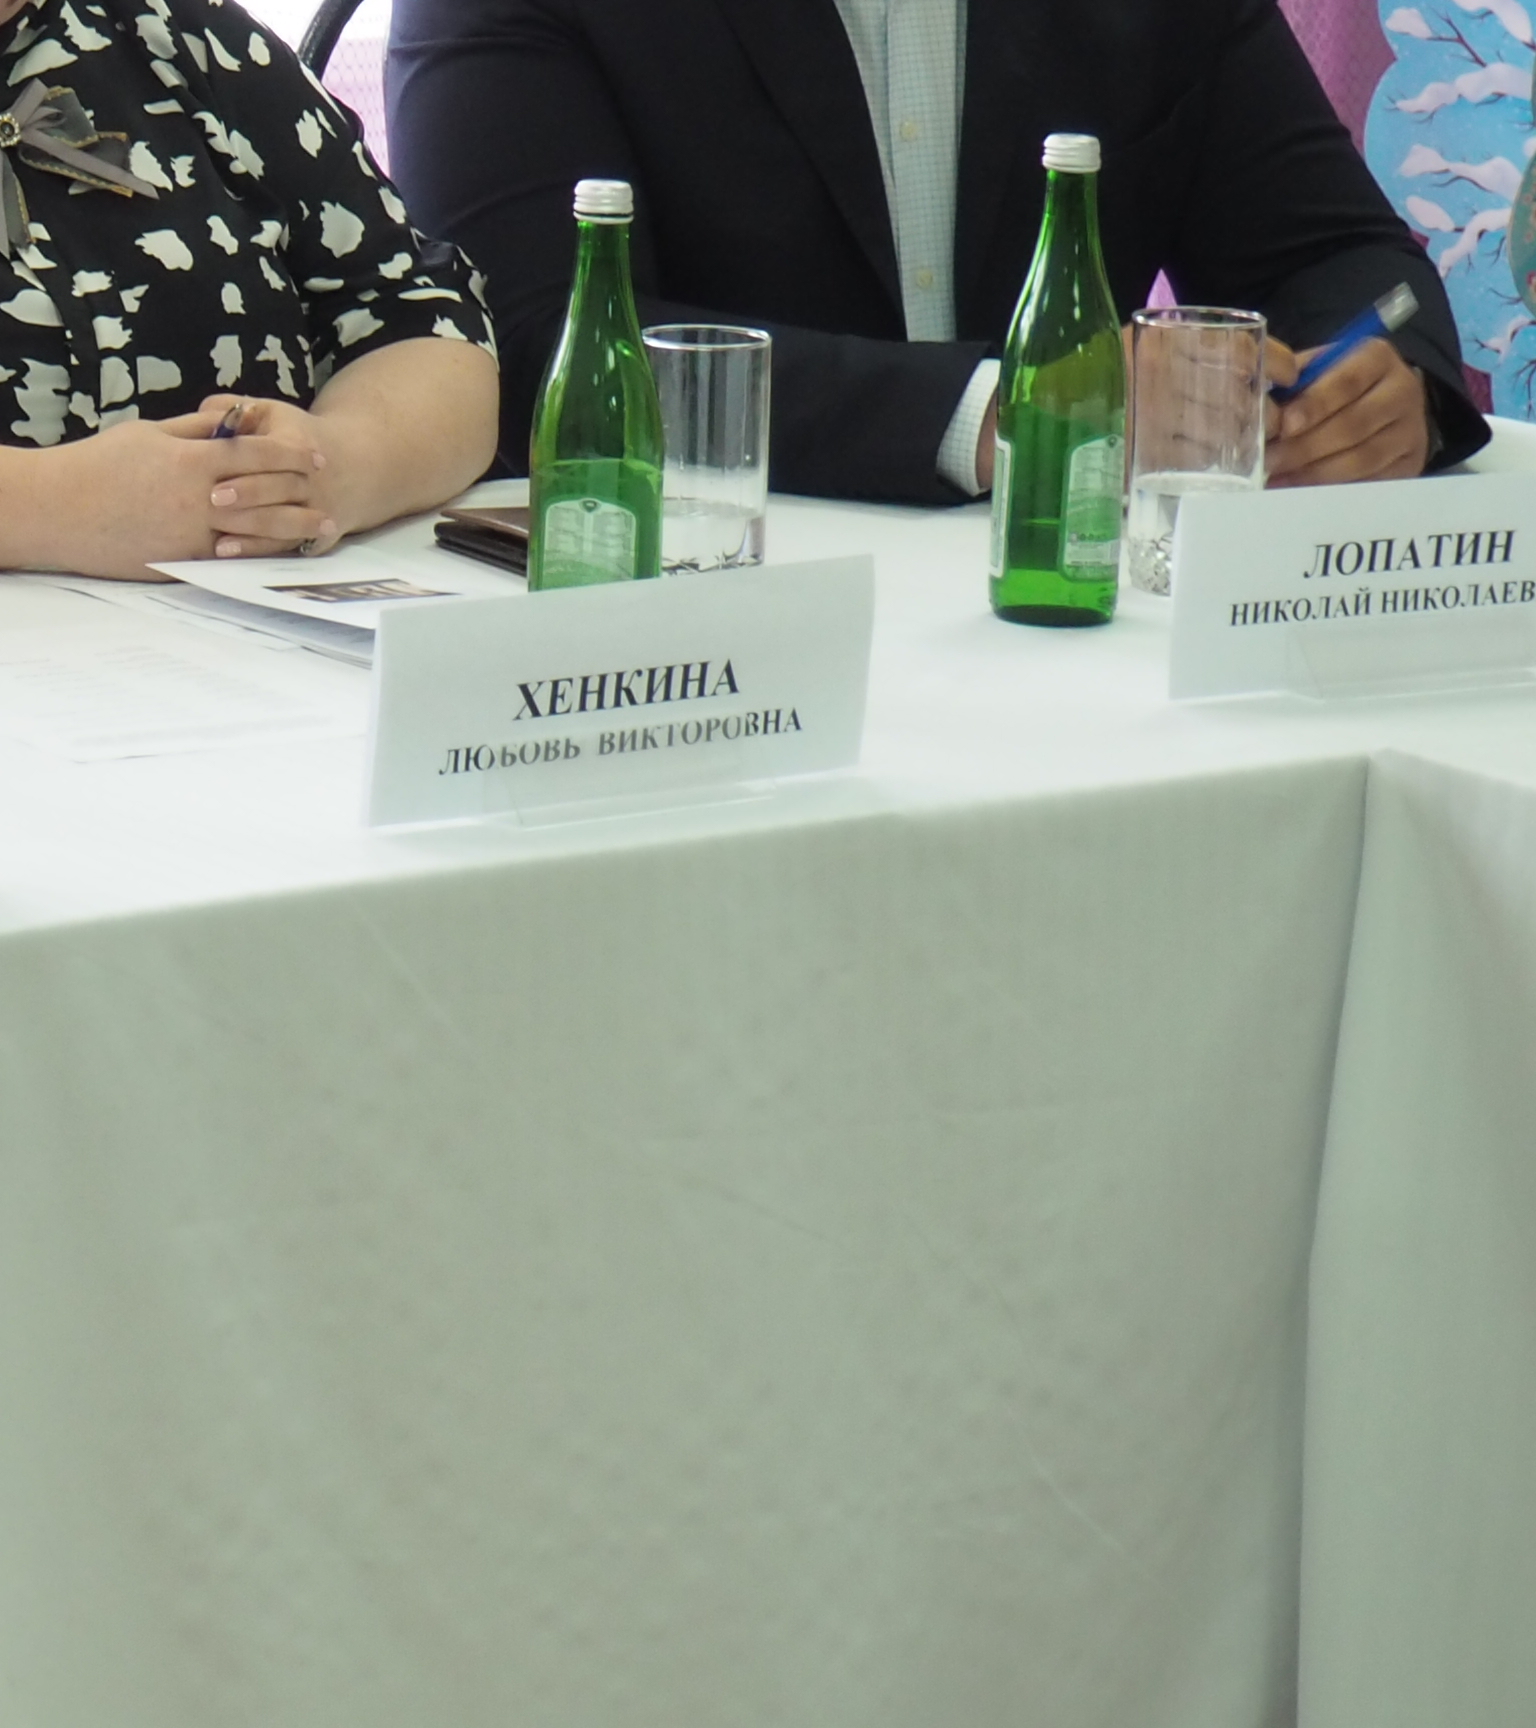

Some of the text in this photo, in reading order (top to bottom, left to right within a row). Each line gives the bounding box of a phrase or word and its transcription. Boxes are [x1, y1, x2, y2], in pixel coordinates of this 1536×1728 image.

[1302, 529, 1517, 579] ЛОПАТИН
[1229, 586, 1373, 627] НИКОЛАЙ
[512, 658, 741, 721] ХЕНКИНА
[438, 707, 803, 776] ЛЮБОВЬ ВИКТОРОВНА
